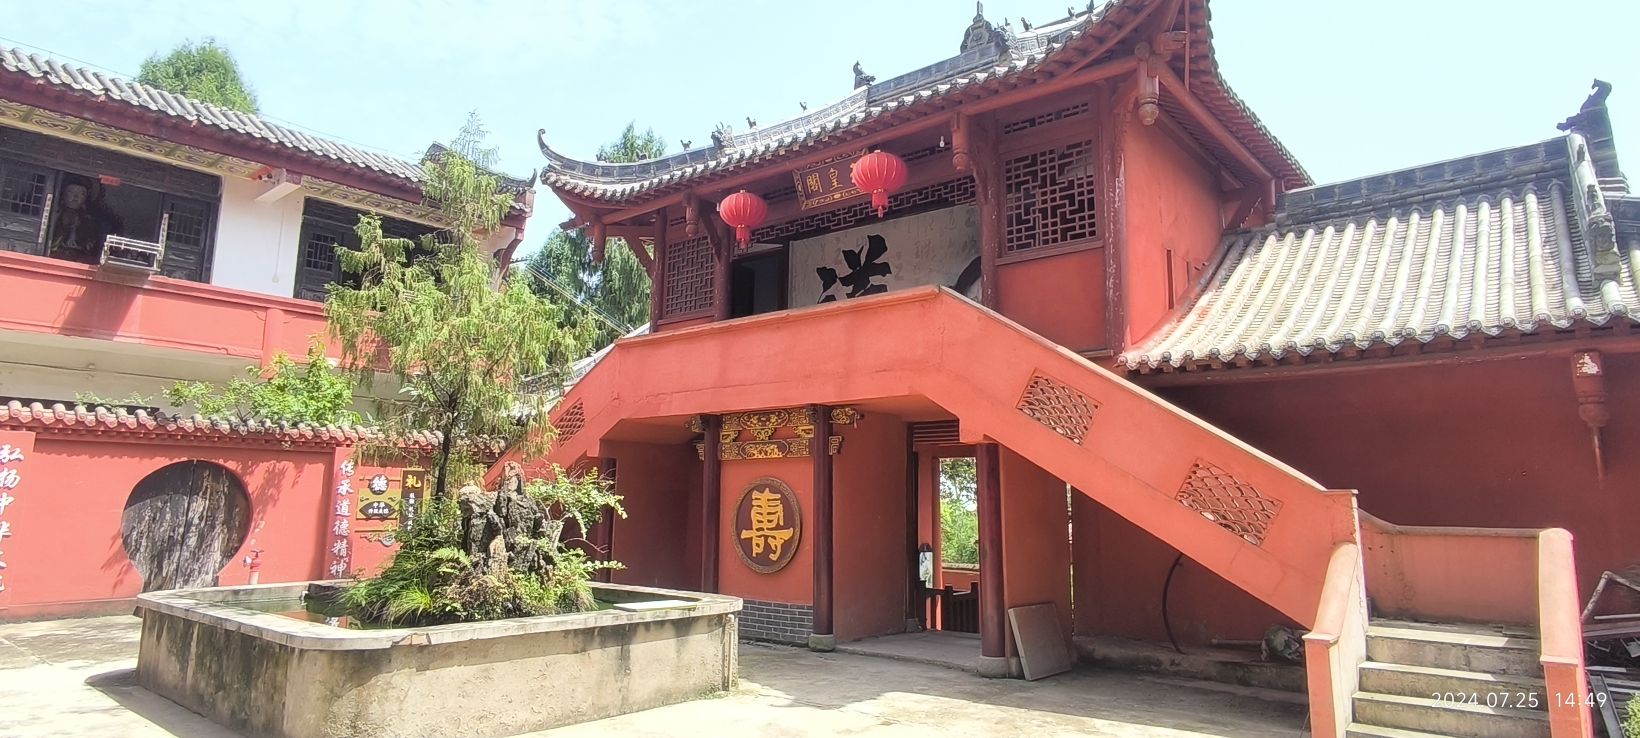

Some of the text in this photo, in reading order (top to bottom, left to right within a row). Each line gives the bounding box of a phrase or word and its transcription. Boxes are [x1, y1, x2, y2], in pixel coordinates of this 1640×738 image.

[806, 165, 854, 194] 皇閣
[0, 444, 25, 592] 弘扬中华
[405, 474, 422, 489] 礼
[330, 459, 355, 579] 传承道德精神
